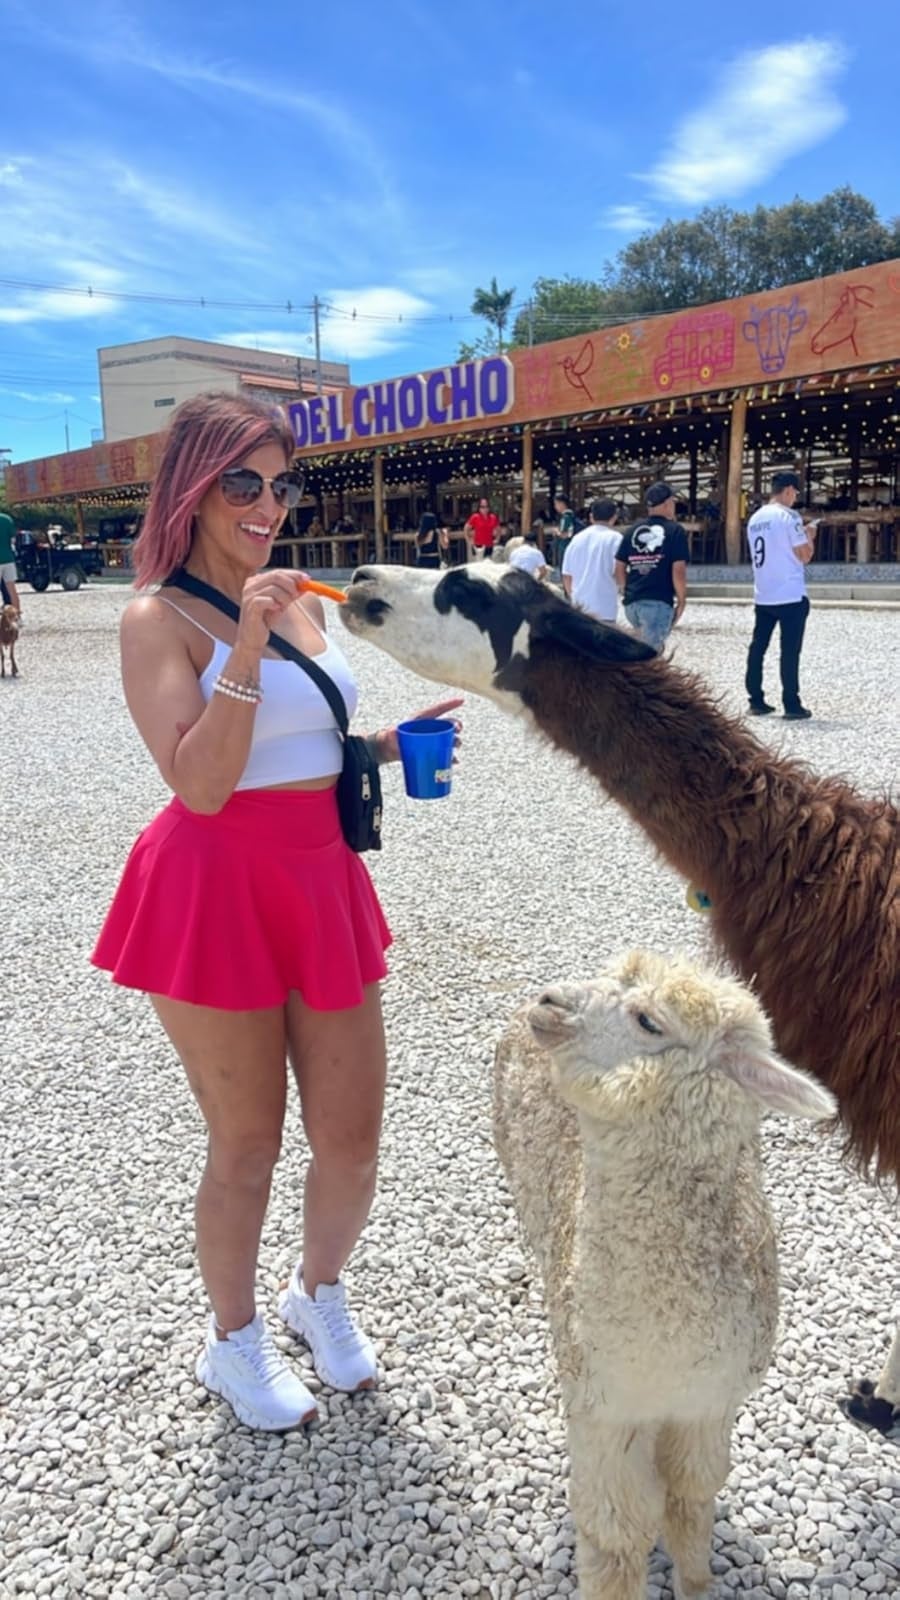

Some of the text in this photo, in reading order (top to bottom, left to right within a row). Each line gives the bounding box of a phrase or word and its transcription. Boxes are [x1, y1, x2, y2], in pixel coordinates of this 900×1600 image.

[288, 356, 512, 447] DEL CHOCHO
[754, 535, 766, 569] 9
